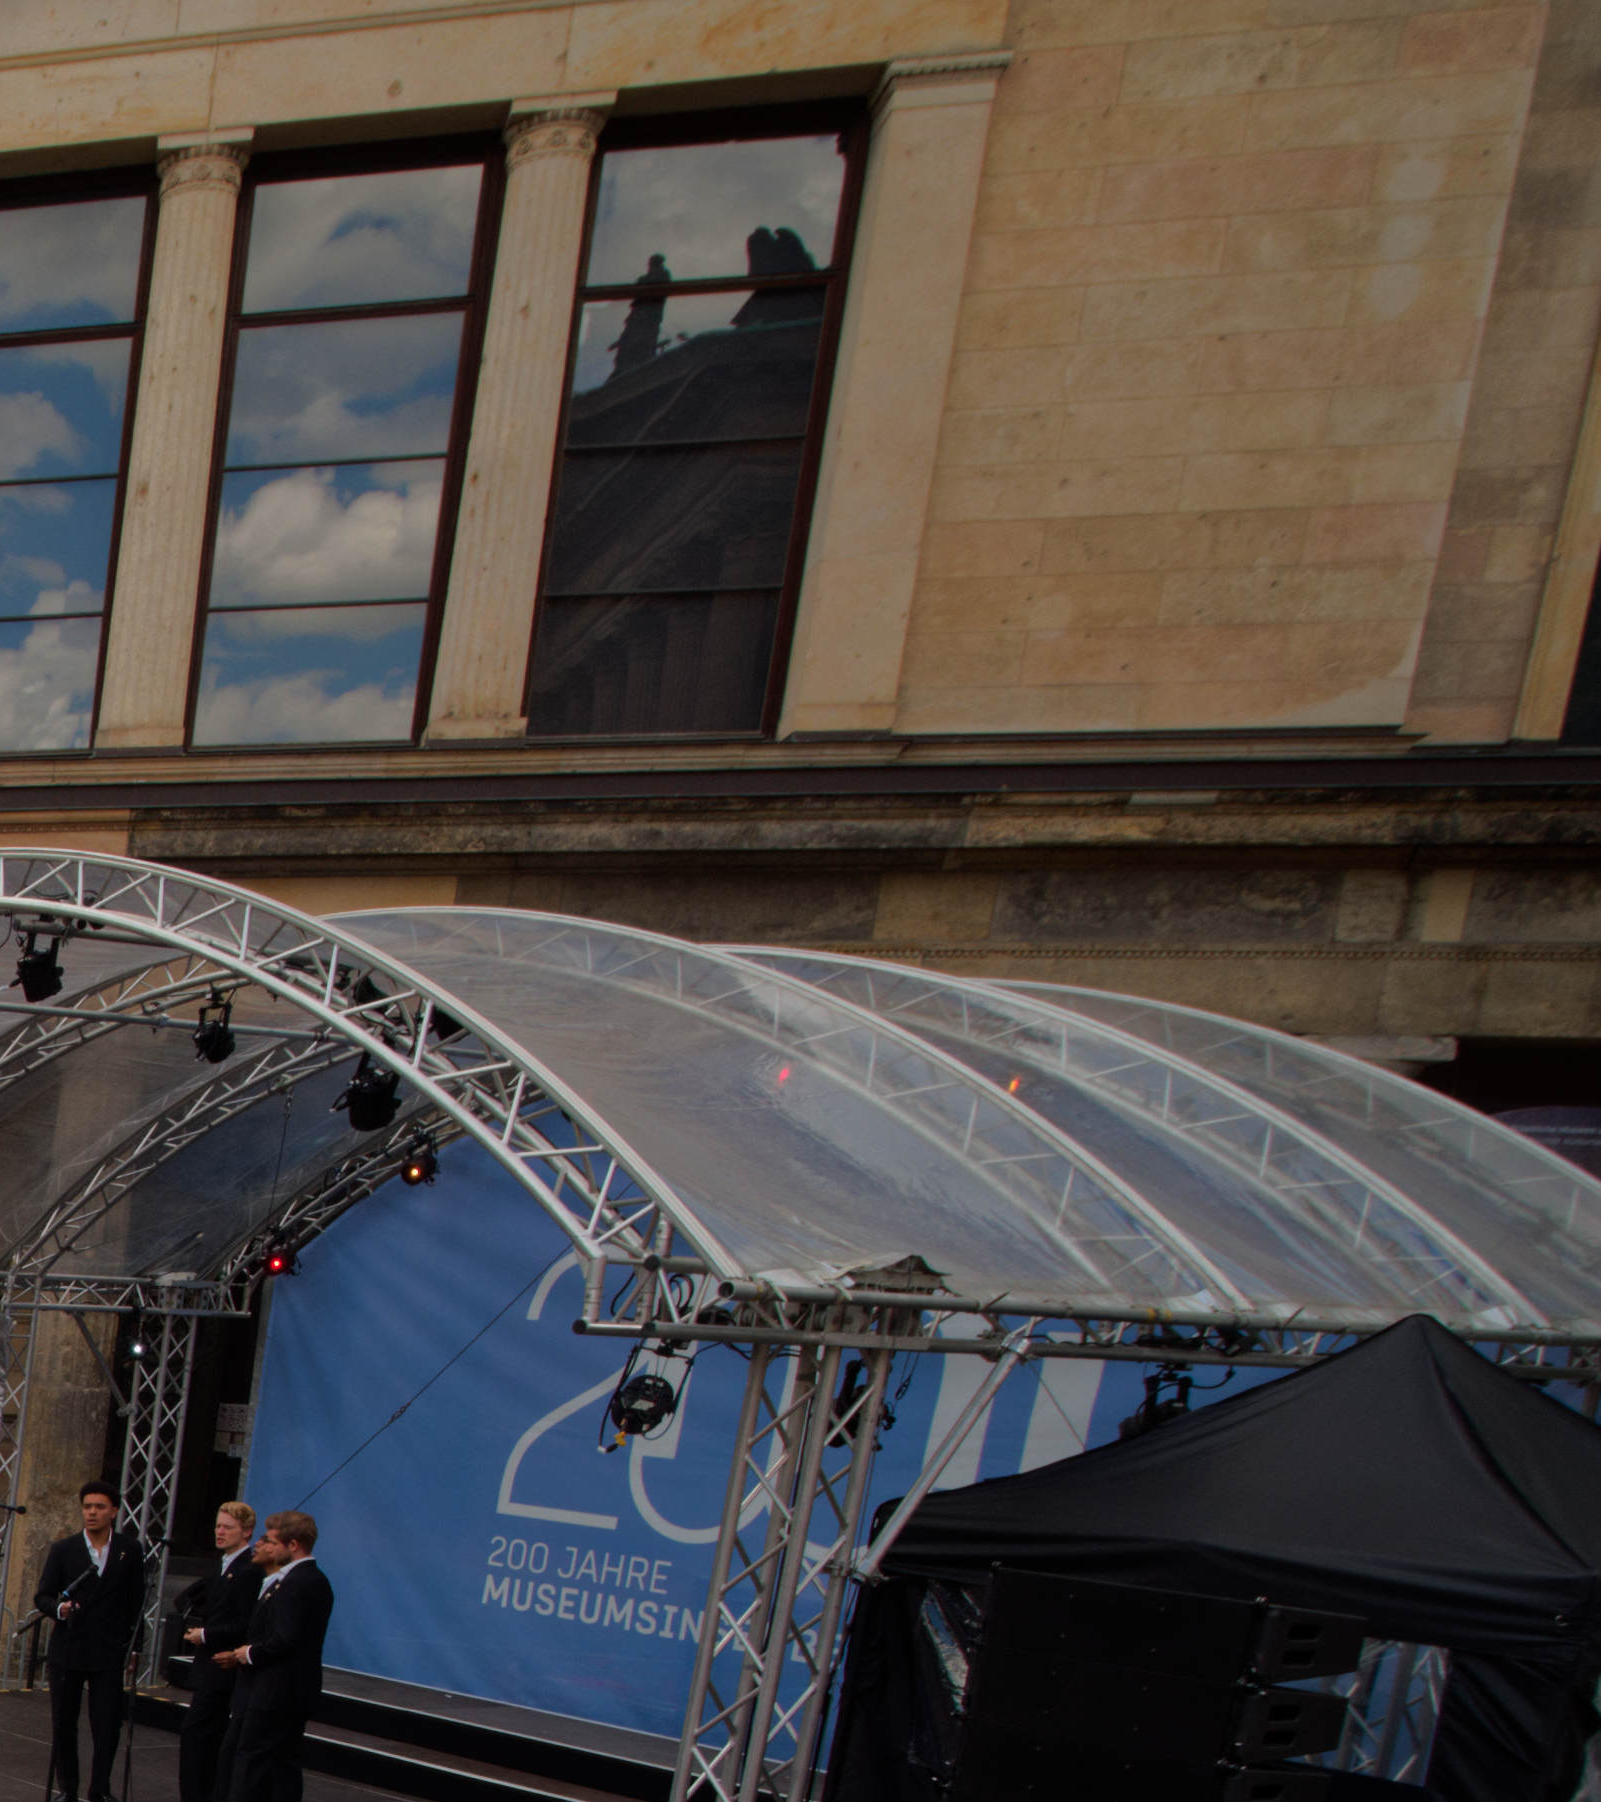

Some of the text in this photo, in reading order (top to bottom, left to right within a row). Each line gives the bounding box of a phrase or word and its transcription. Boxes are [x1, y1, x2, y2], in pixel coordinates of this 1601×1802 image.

[488, 1535, 673, 1595] 200 JAHRE
[481, 1574, 751, 1651] MUSEUMSIN
